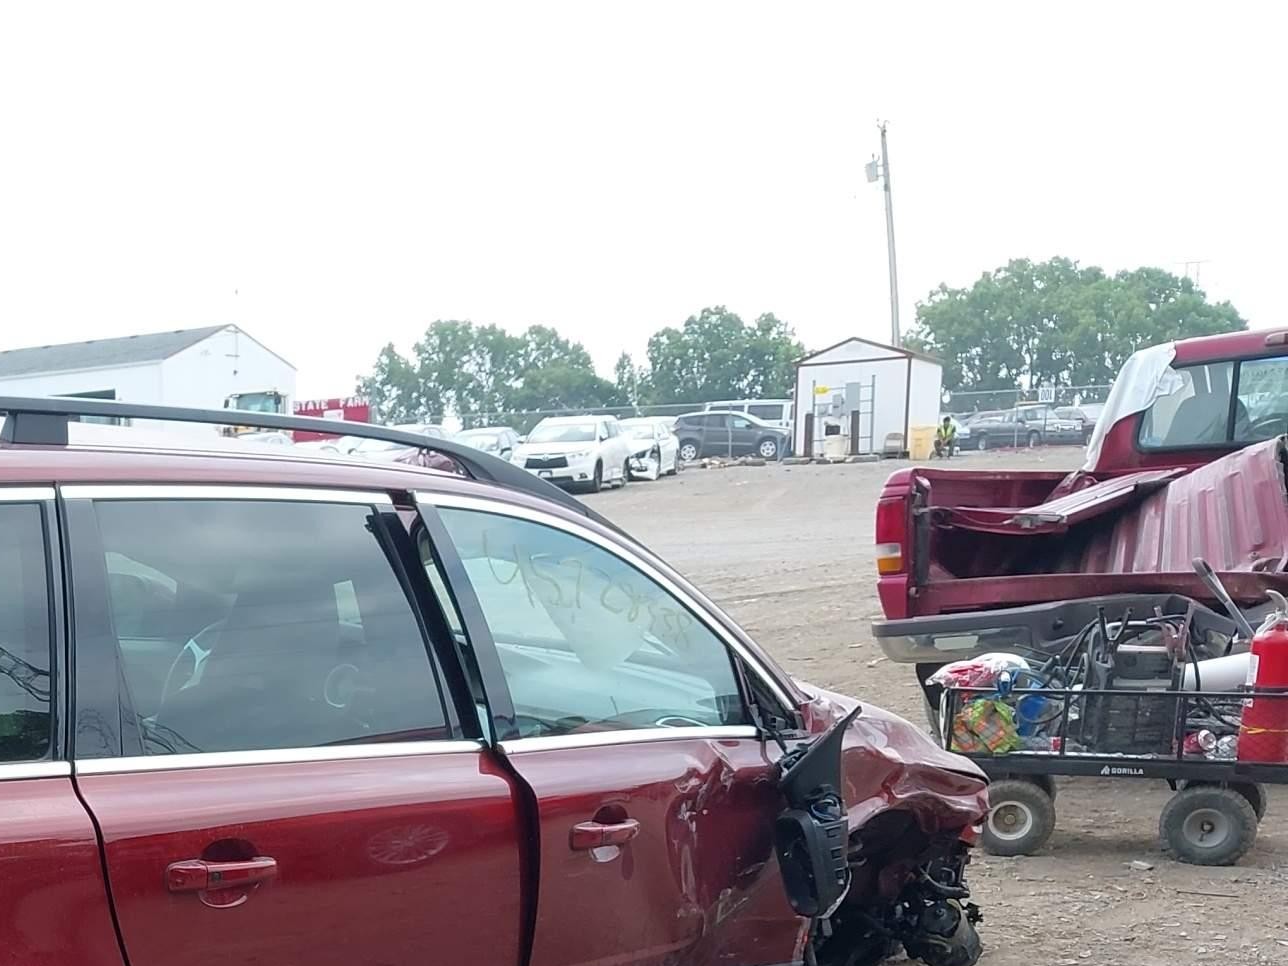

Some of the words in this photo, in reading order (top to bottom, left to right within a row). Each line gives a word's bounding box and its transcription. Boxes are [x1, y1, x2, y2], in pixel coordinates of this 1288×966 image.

[294, 400, 328, 412] STATE
[339, 396, 369, 408] FARM
[1111, 767, 1144, 775] GORILLA
